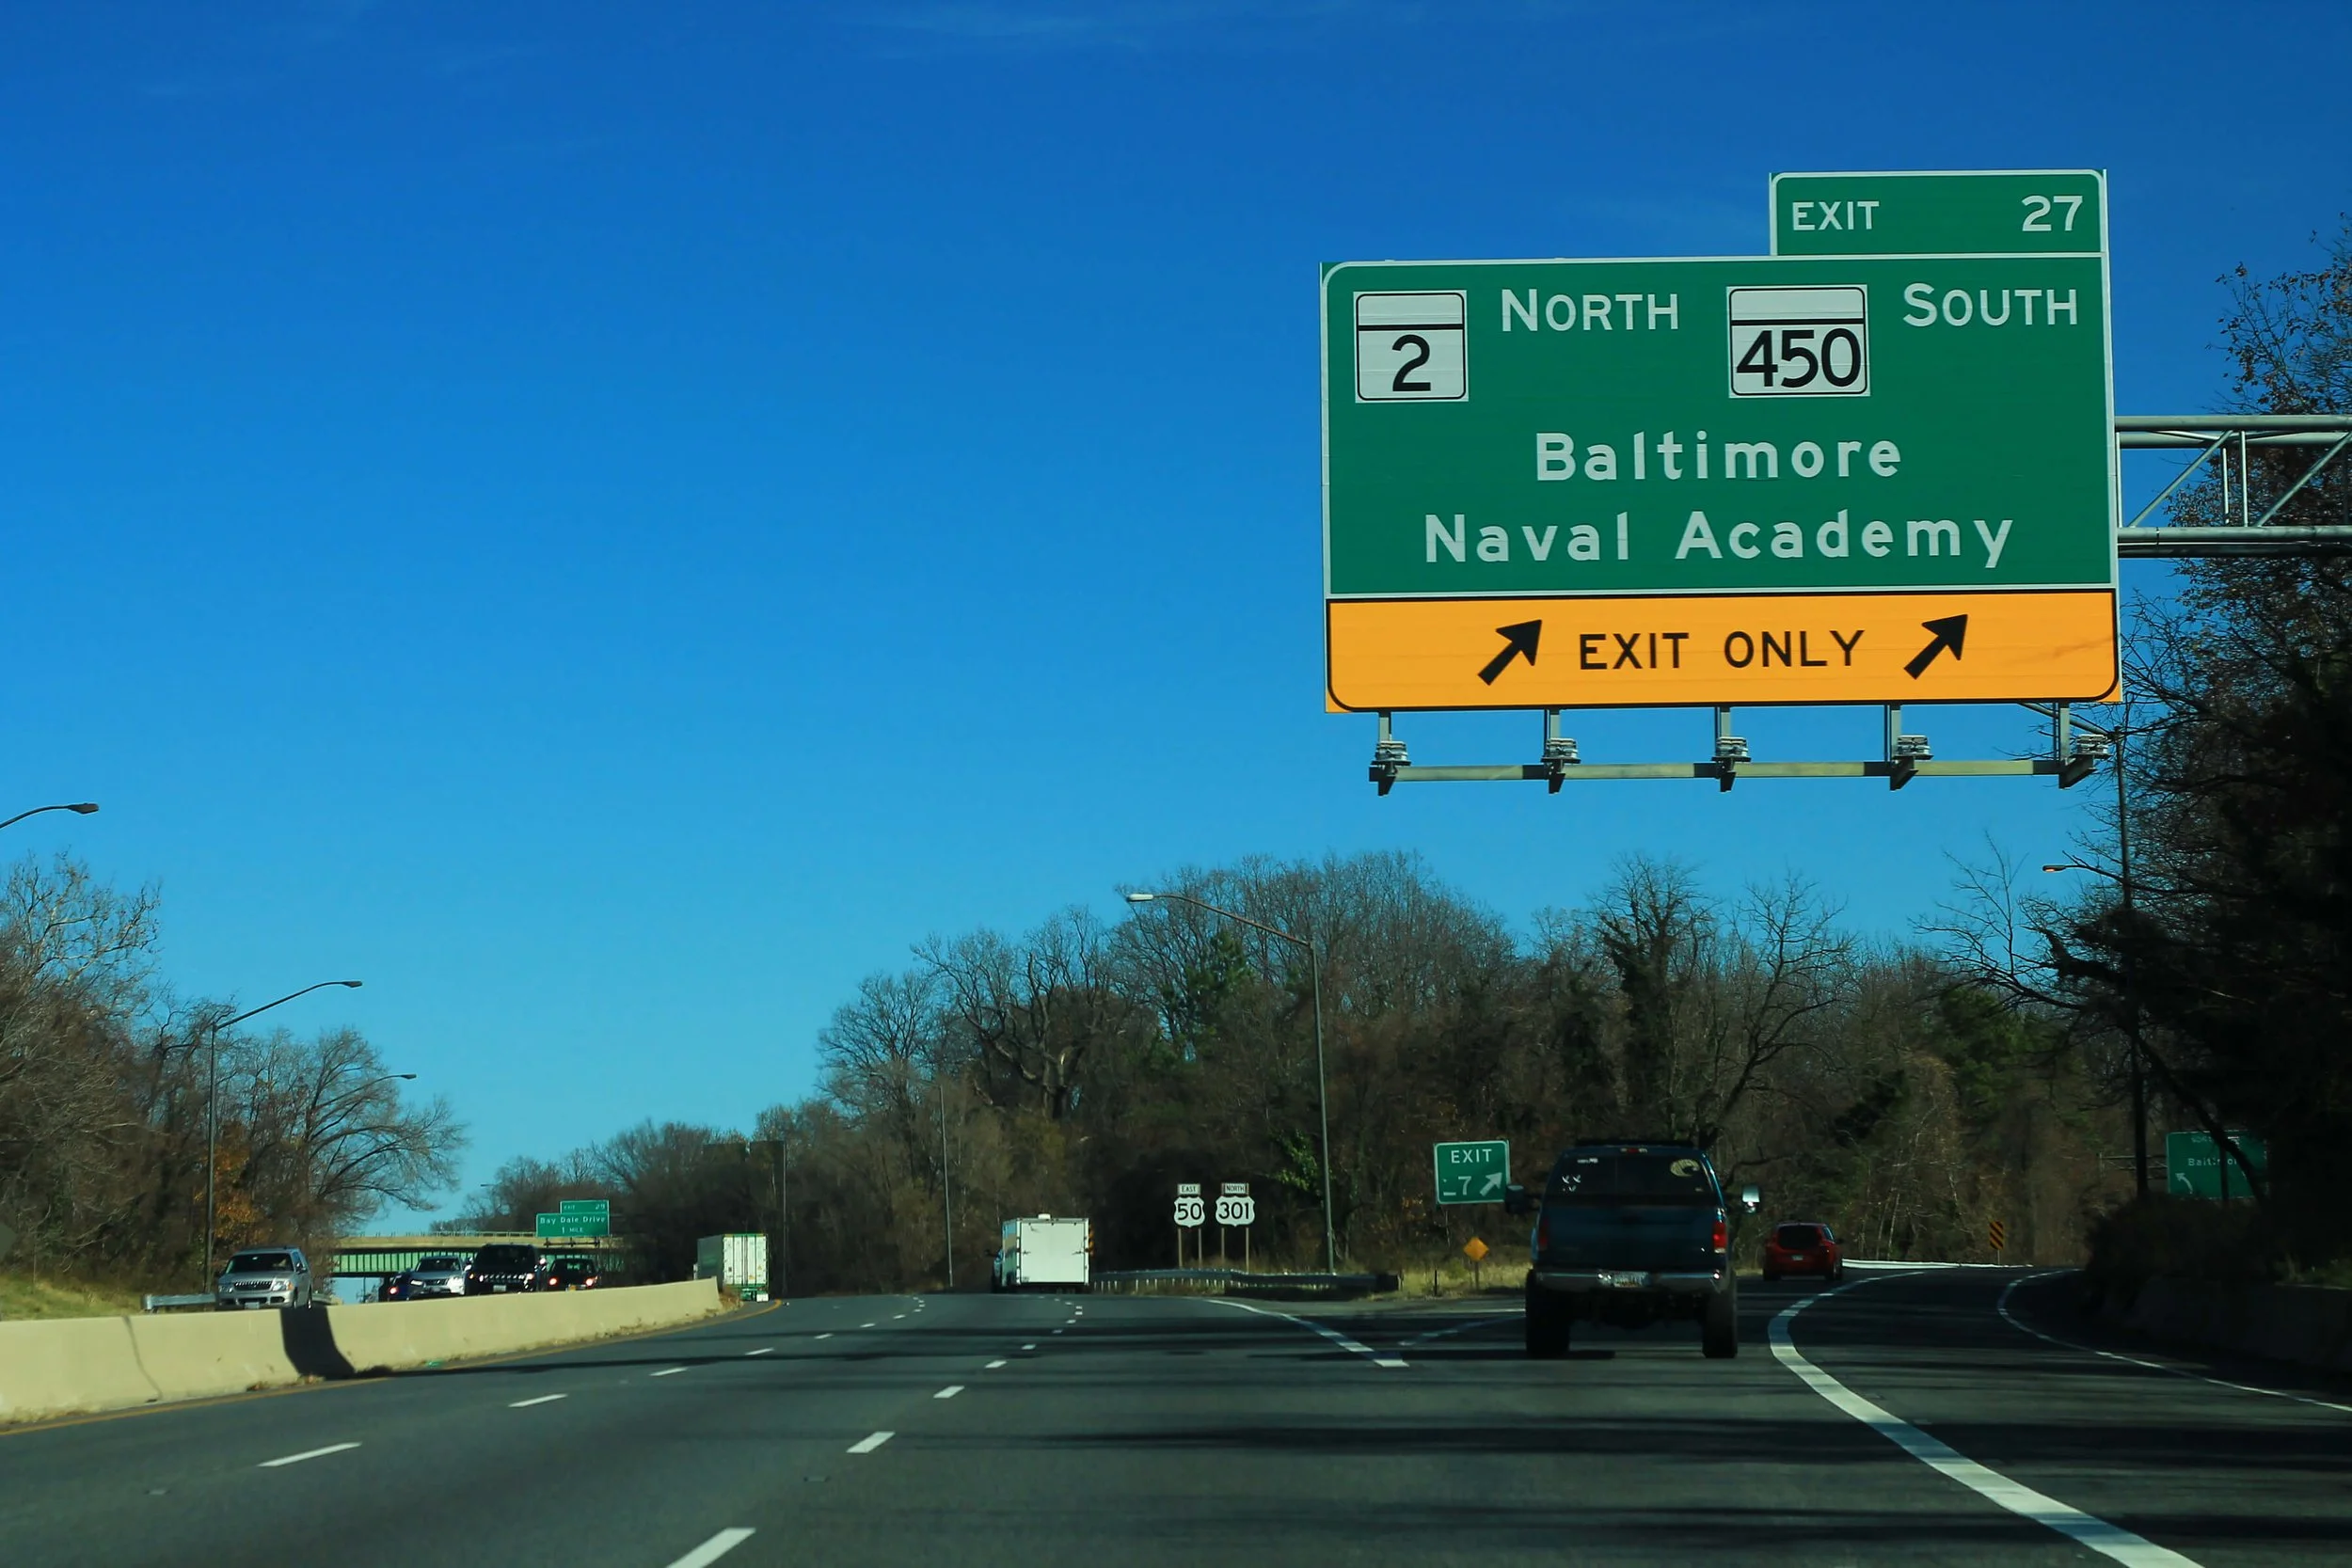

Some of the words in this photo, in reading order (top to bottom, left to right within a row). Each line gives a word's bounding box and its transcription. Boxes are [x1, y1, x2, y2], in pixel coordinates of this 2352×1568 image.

[1792, 200, 1880, 230] EXIT
[2021, 195, 2083, 231] 27
[1502, 288, 1679, 332] NORTH
[1903, 282, 2078, 327] SOUTH
[1391, 334, 1432, 392] 2
[1736, 326, 1863, 388] 450
[1536, 430, 1901, 482] Baltimore
[1425, 511, 1629, 562] Naval
[1675, 509, 2013, 569] Academy
[1580, 632, 1689, 670] EXIT
[1724, 629, 1864, 669] ONLY
[1451, 1148, 1492, 1164] EXIT
[1178, 1203, 1202, 1221] 50
[1218, 1202, 1249, 1220] 301
